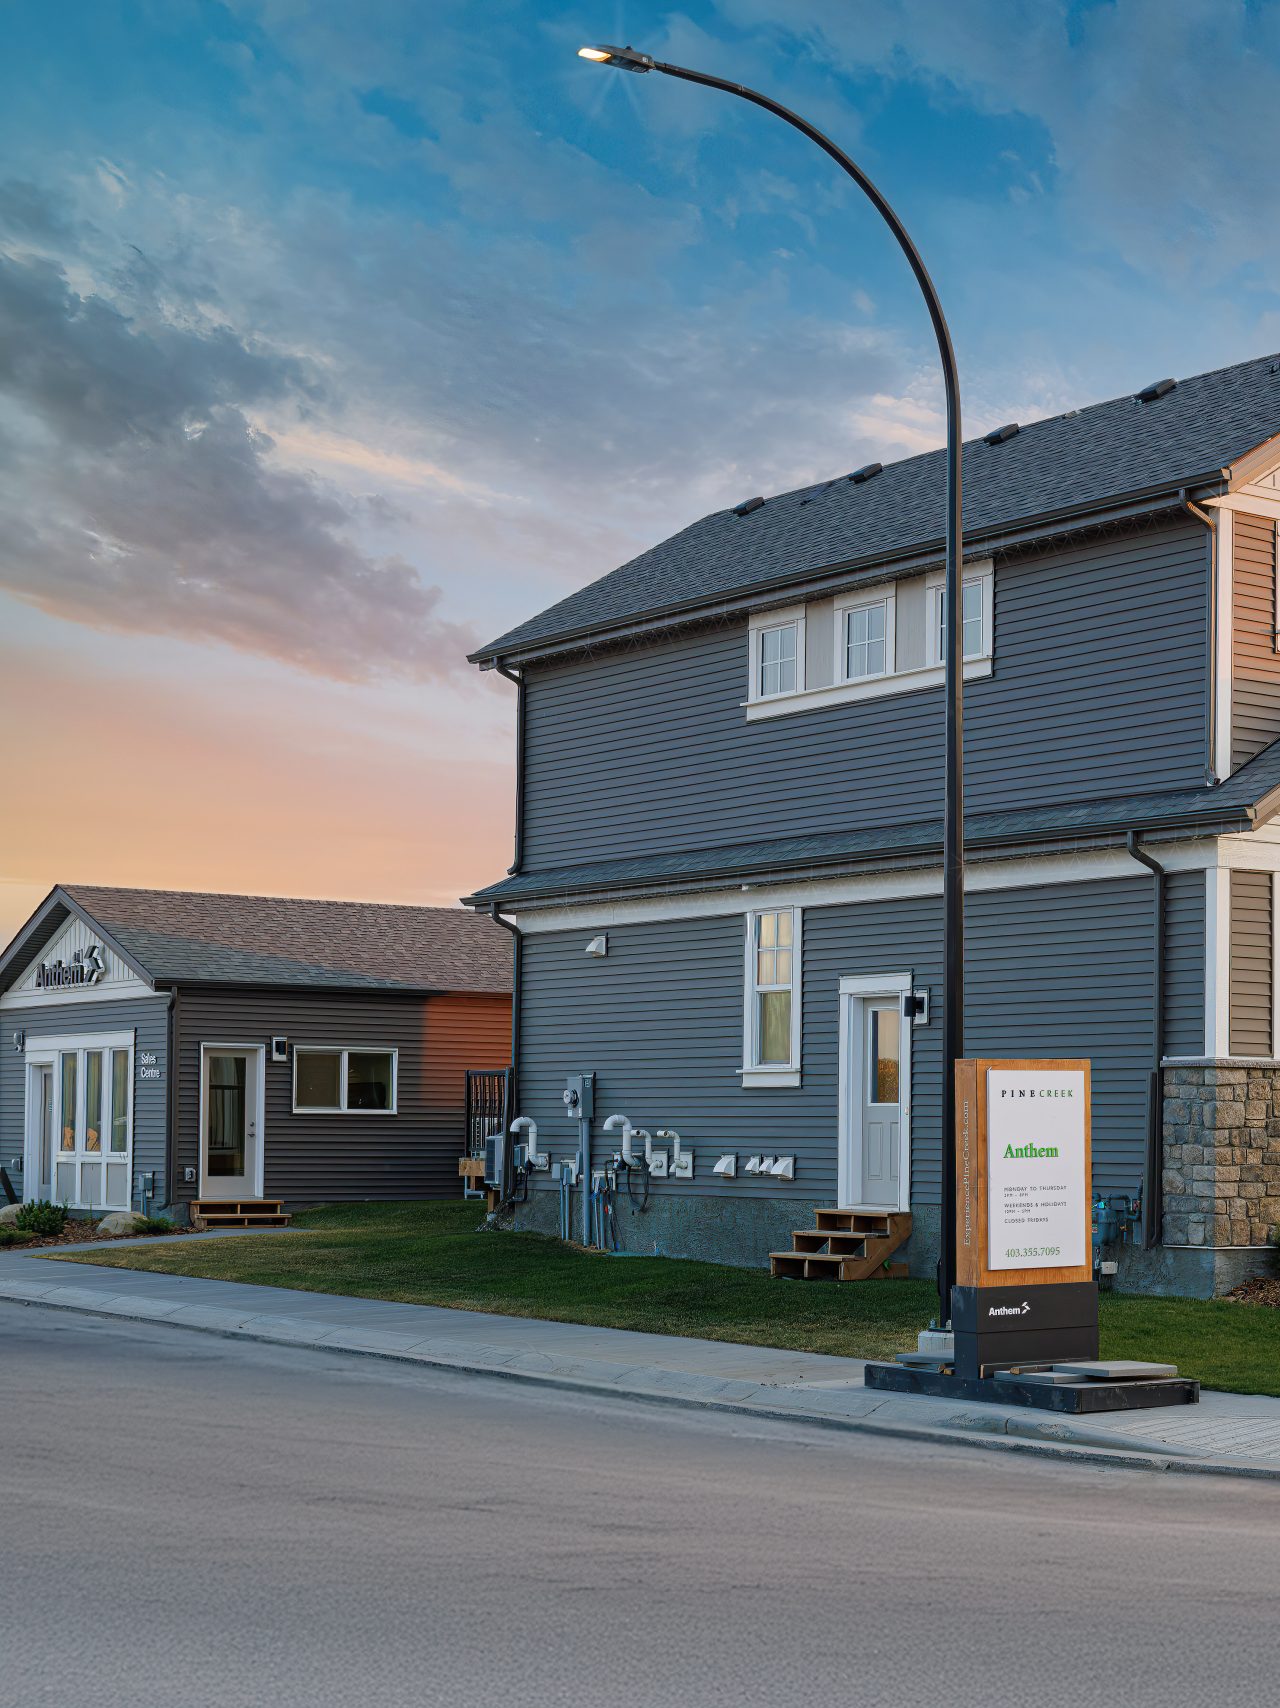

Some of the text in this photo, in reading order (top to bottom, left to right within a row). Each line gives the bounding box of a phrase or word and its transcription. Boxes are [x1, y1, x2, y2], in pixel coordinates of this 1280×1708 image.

[35, 959, 85, 988] Anthem
[141, 1052, 157, 1065] Sales
[140, 1067, 161, 1079] Centre
[1003, 1142, 1059, 1159] Anthem
[1005, 1247, 1061, 1258] 403.355.7095
[988, 1306, 1021, 1316] Anthem
